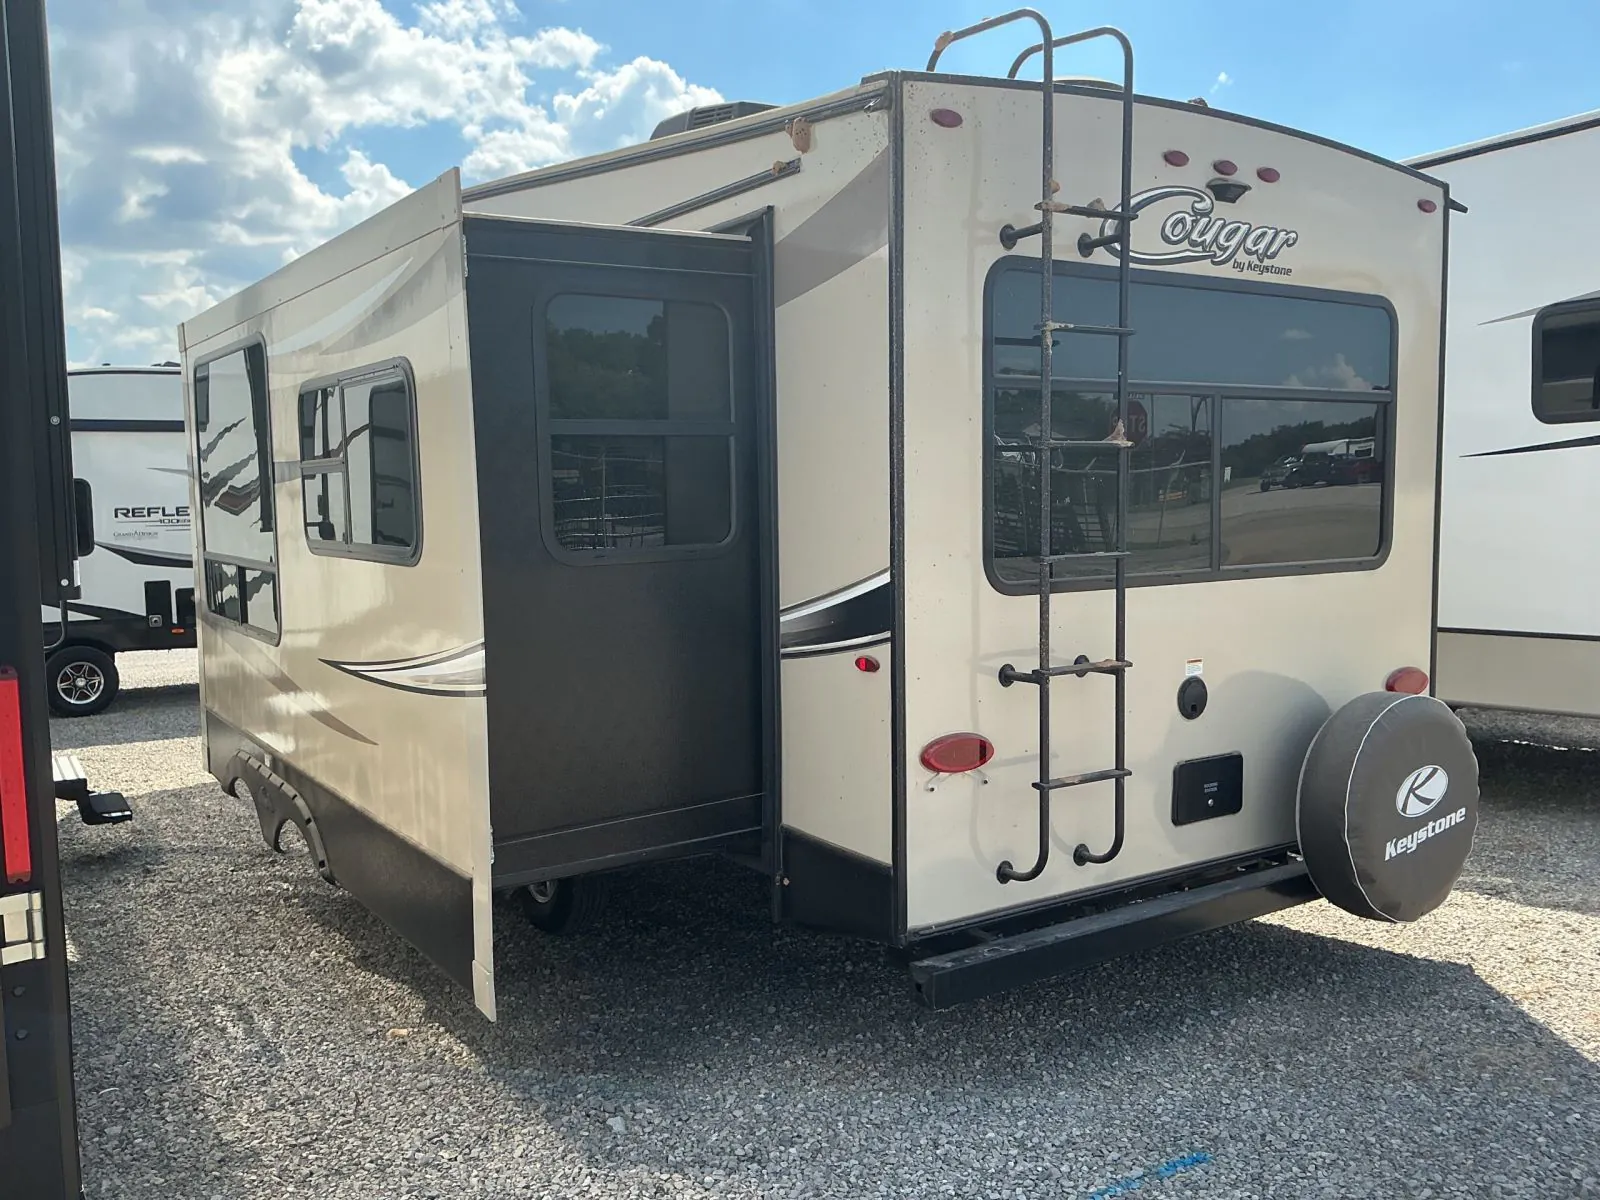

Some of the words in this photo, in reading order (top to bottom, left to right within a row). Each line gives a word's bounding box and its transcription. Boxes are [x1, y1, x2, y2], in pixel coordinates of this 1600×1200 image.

[1100, 185, 1298, 265] Cougar
[1232, 258, 1245, 273] by
[1247, 260, 1292, 276] Keystone
[1384, 807, 1466, 861] Keystone
